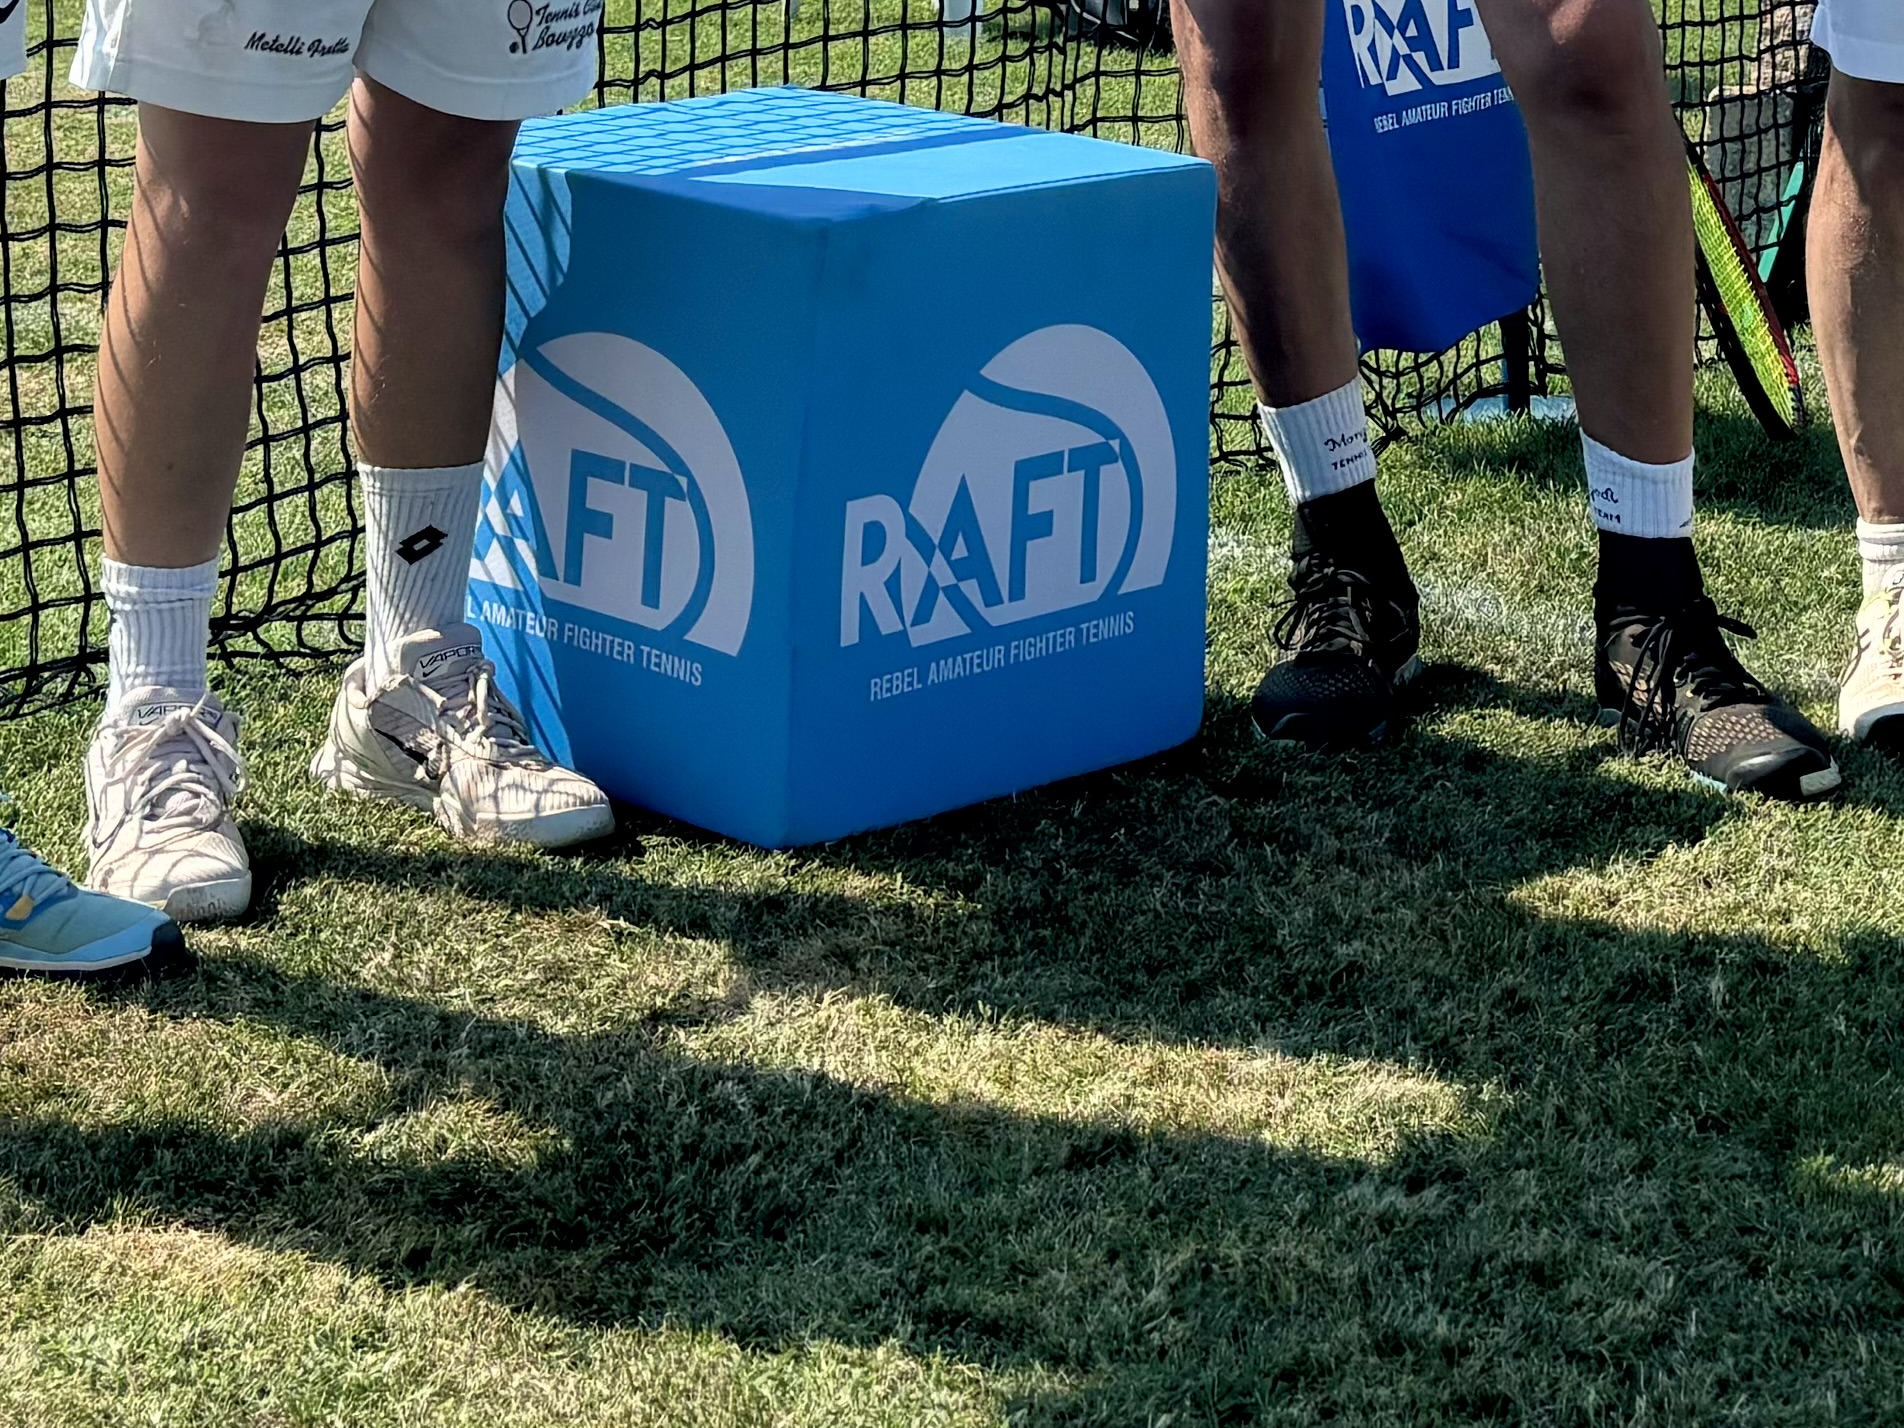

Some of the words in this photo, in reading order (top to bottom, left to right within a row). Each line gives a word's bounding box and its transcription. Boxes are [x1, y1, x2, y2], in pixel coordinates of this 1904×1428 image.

[244, 31, 305, 56] Metelli
[535, 3, 580, 27] Tennis
[1401, 101, 1449, 127] AMATEUR
[1452, 91, 1492, 117] FIGHTER
[472, 439, 688, 611] AFT
[840, 440, 1121, 648] RAFT
[481, 600, 559, 641] AMATEUR
[563, 623, 635, 665] FIGHTER
[640, 645, 703, 686] TENNIS
[870, 667, 923, 702] REBEL
[927, 645, 1006, 686] AMATEUR
[1009, 626, 1076, 665] FIGHTER
[1079, 610, 1135, 646] TENNIS
